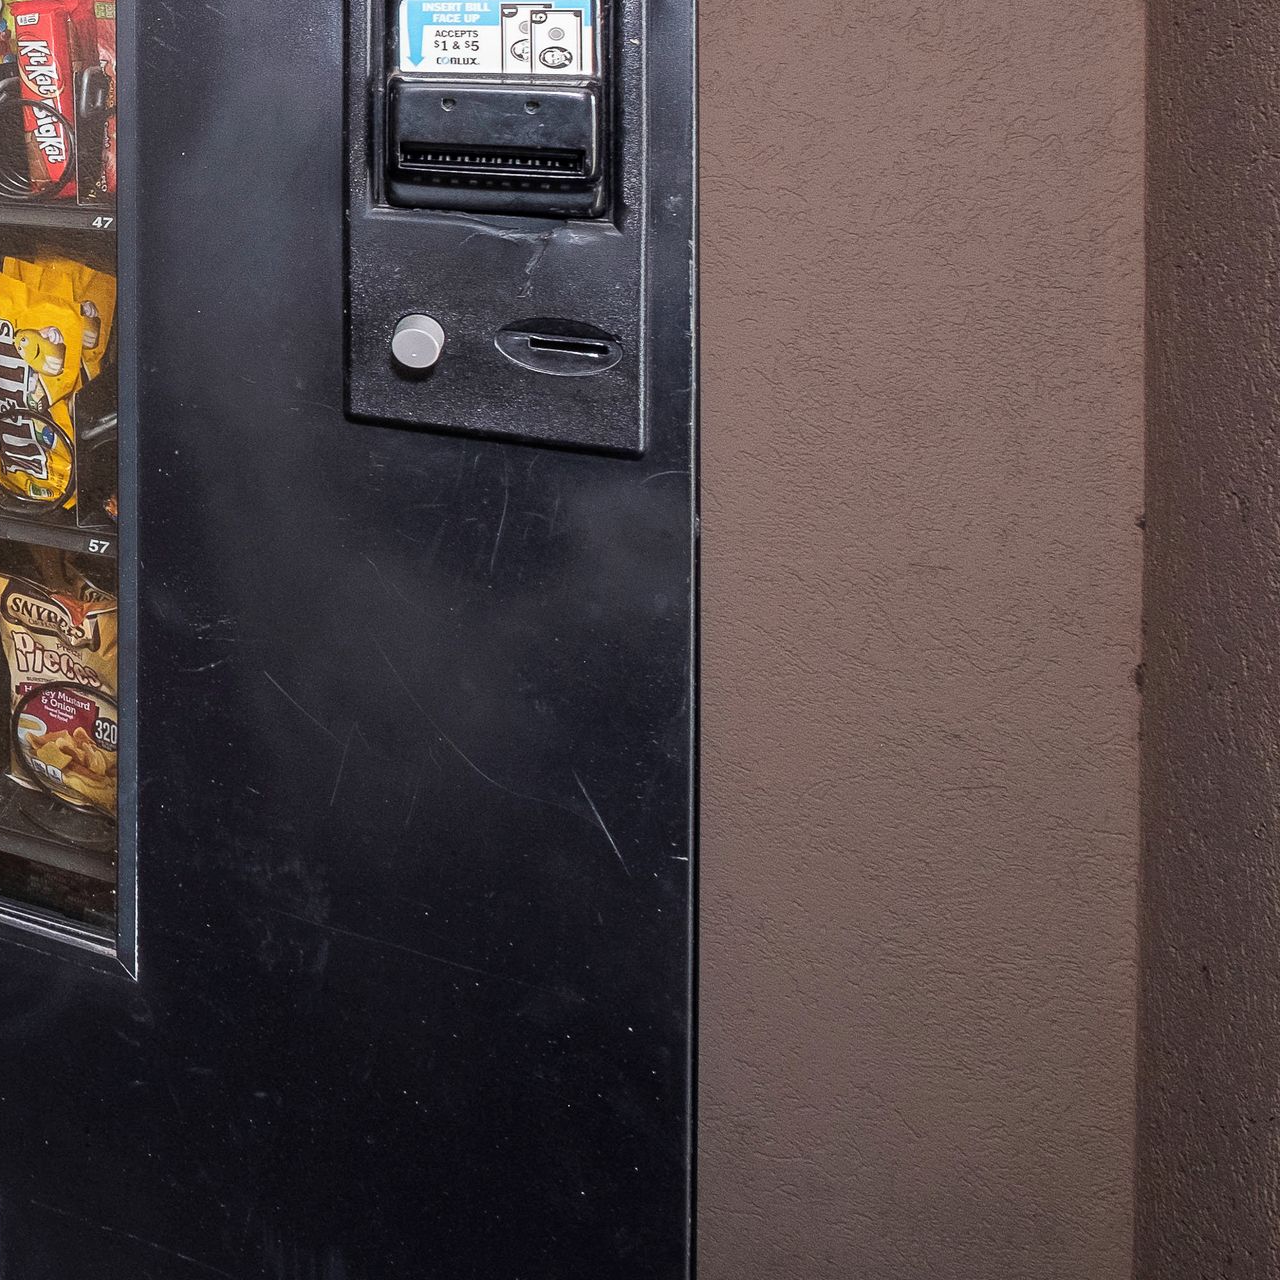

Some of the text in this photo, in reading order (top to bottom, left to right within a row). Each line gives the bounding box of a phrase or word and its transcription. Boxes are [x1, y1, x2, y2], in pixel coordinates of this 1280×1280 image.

[422, 2, 492, 13] INSERT BILL
[432, 13, 481, 24] FACE UP
[434, 29, 479, 38] ACCEPTS
[433, 39, 480, 52] $1 & $5
[92, 217, 113, 229] 47
[88, 540, 109, 554] 57
[11, 630, 101, 689] Pieces
[57, 689, 90, 711] Mustard
[49, 699, 76, 715] Onion
[95, 720, 117, 744] 320
